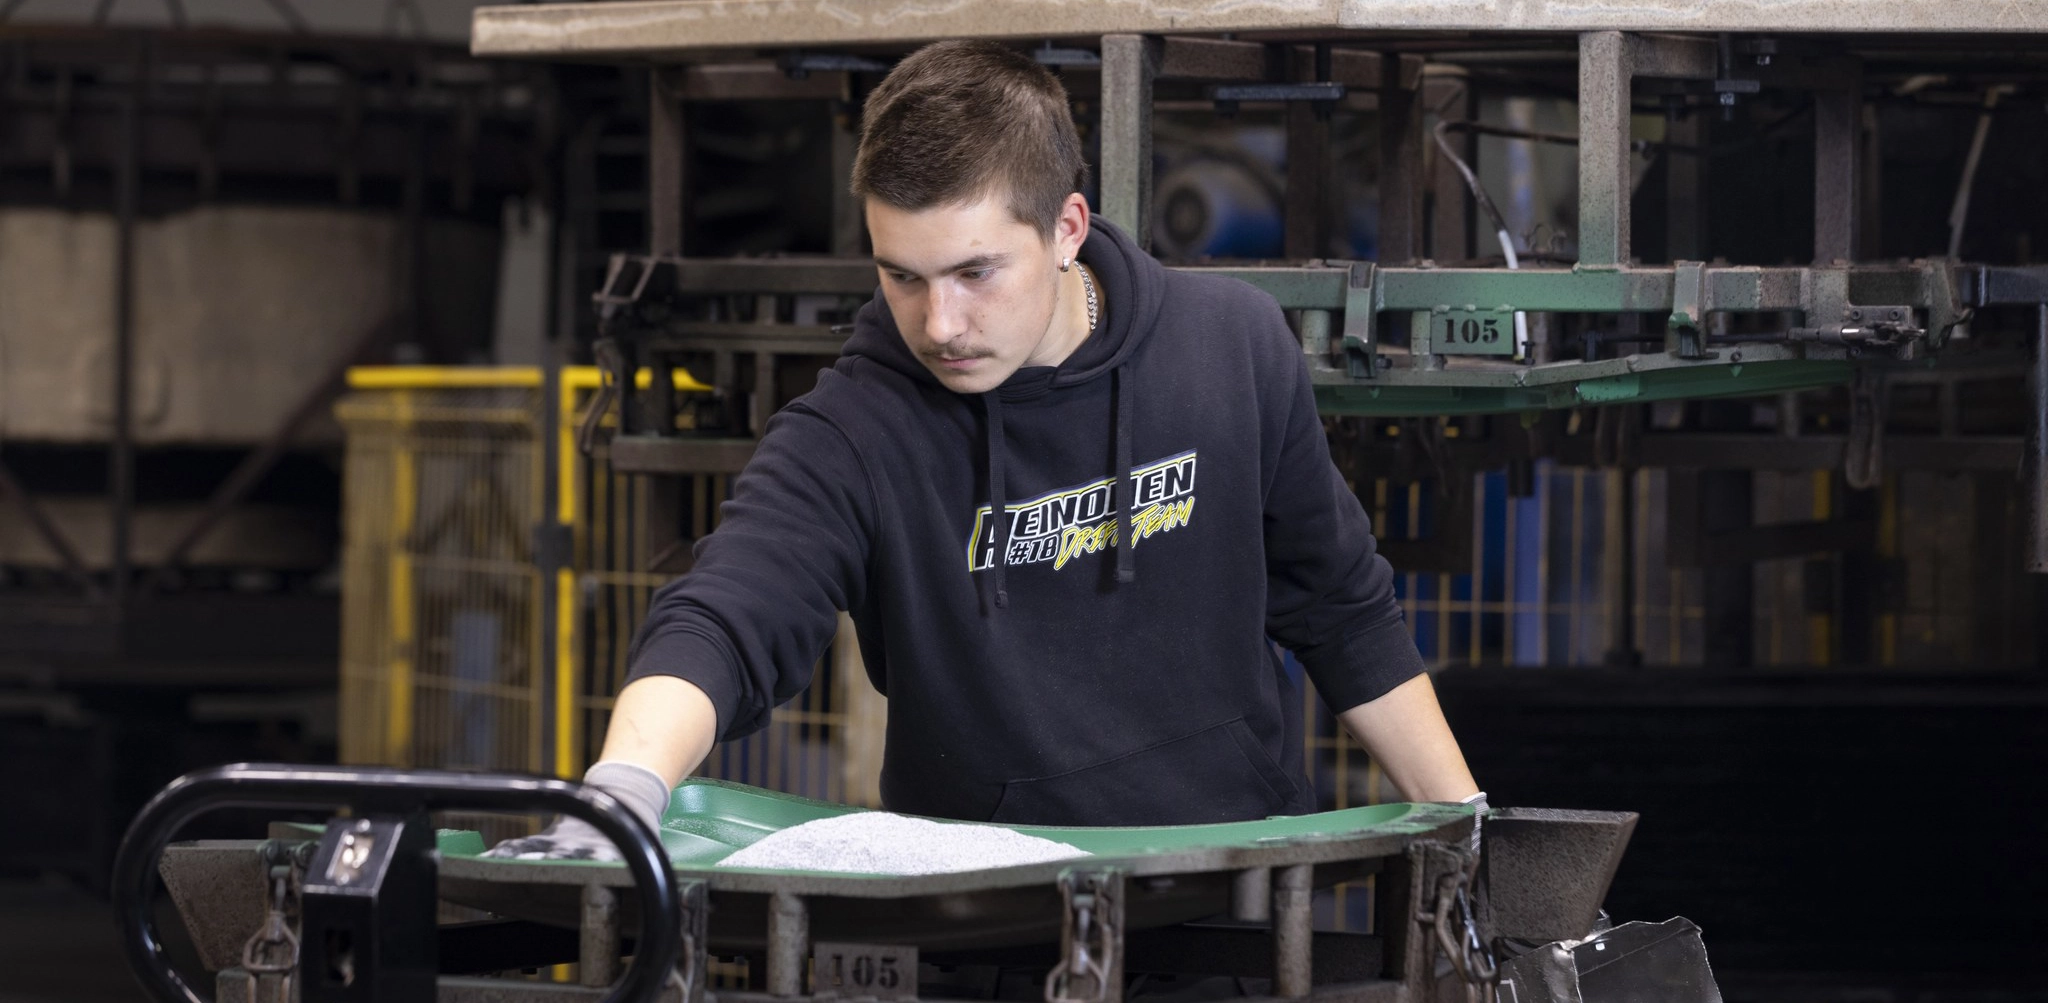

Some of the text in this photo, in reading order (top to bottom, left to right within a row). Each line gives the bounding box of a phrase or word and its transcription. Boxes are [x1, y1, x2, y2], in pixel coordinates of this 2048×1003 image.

[1445, 319, 1499, 344] 105
[1008, 534, 1058, 565] #18
[1130, 495, 1196, 549] TEAM
[832, 953, 899, 989] 105
